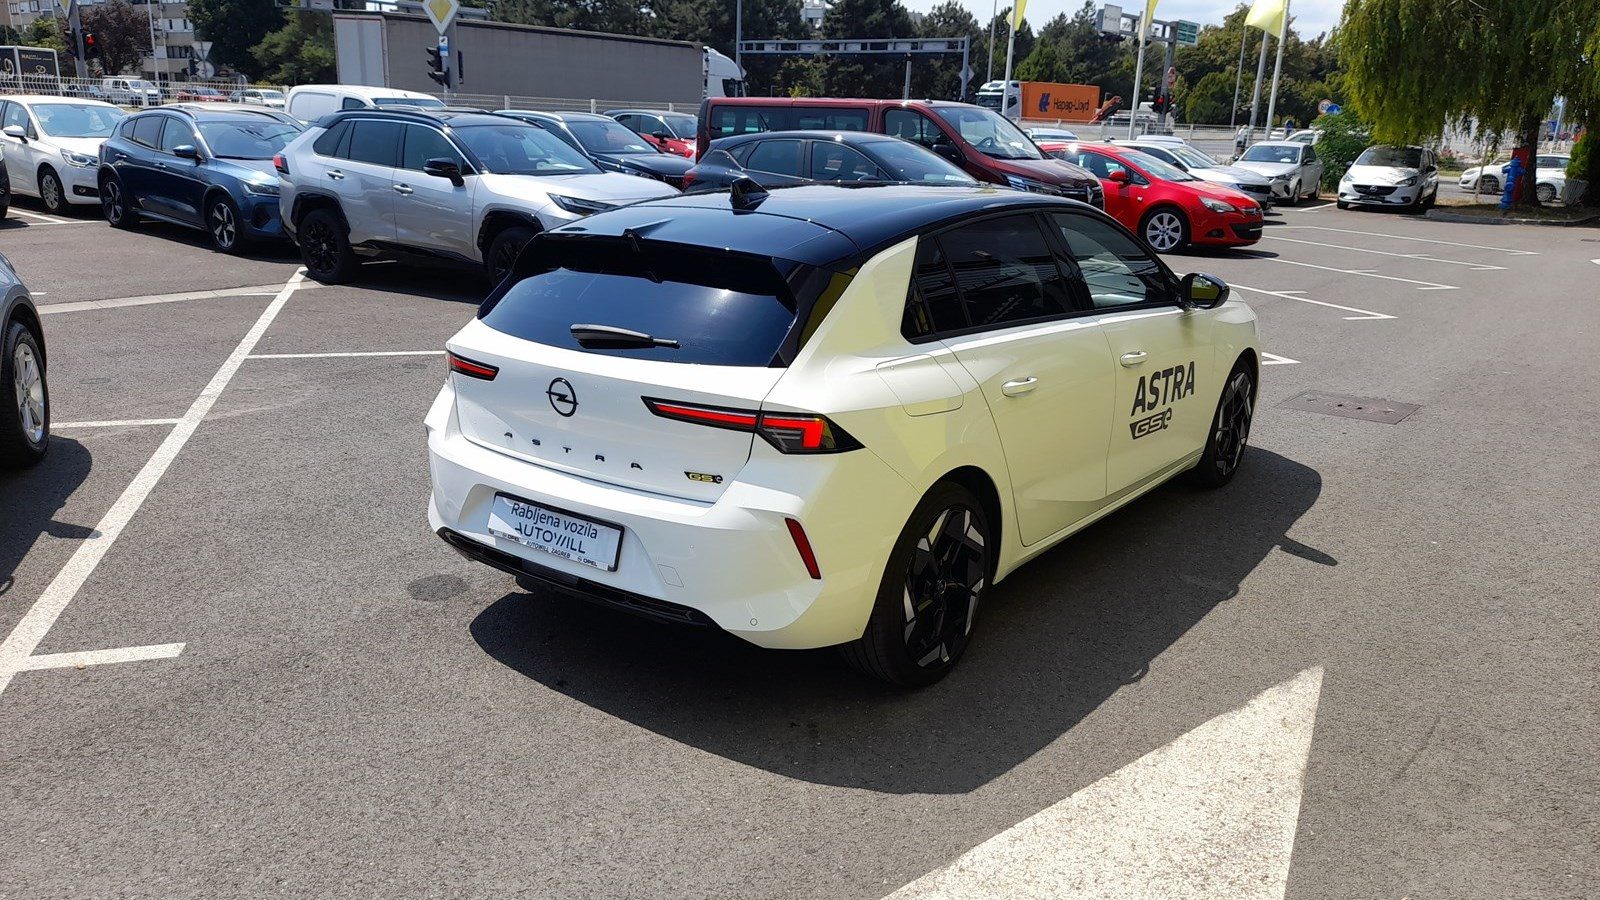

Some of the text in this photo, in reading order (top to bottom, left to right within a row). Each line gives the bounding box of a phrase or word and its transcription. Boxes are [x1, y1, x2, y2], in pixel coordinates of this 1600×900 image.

[1053, 98, 1090, 113] Hapag-Lloyd
[1131, 361, 1195, 417] ASTRA
[504, 432, 643, 471] ASTRA
[511, 502, 598, 540] Rabljena vozila
[514, 522, 586, 554] AUTOWILL
[507, 534, 598, 567] OPEL AUTOWILL ZAGREB OPEL
